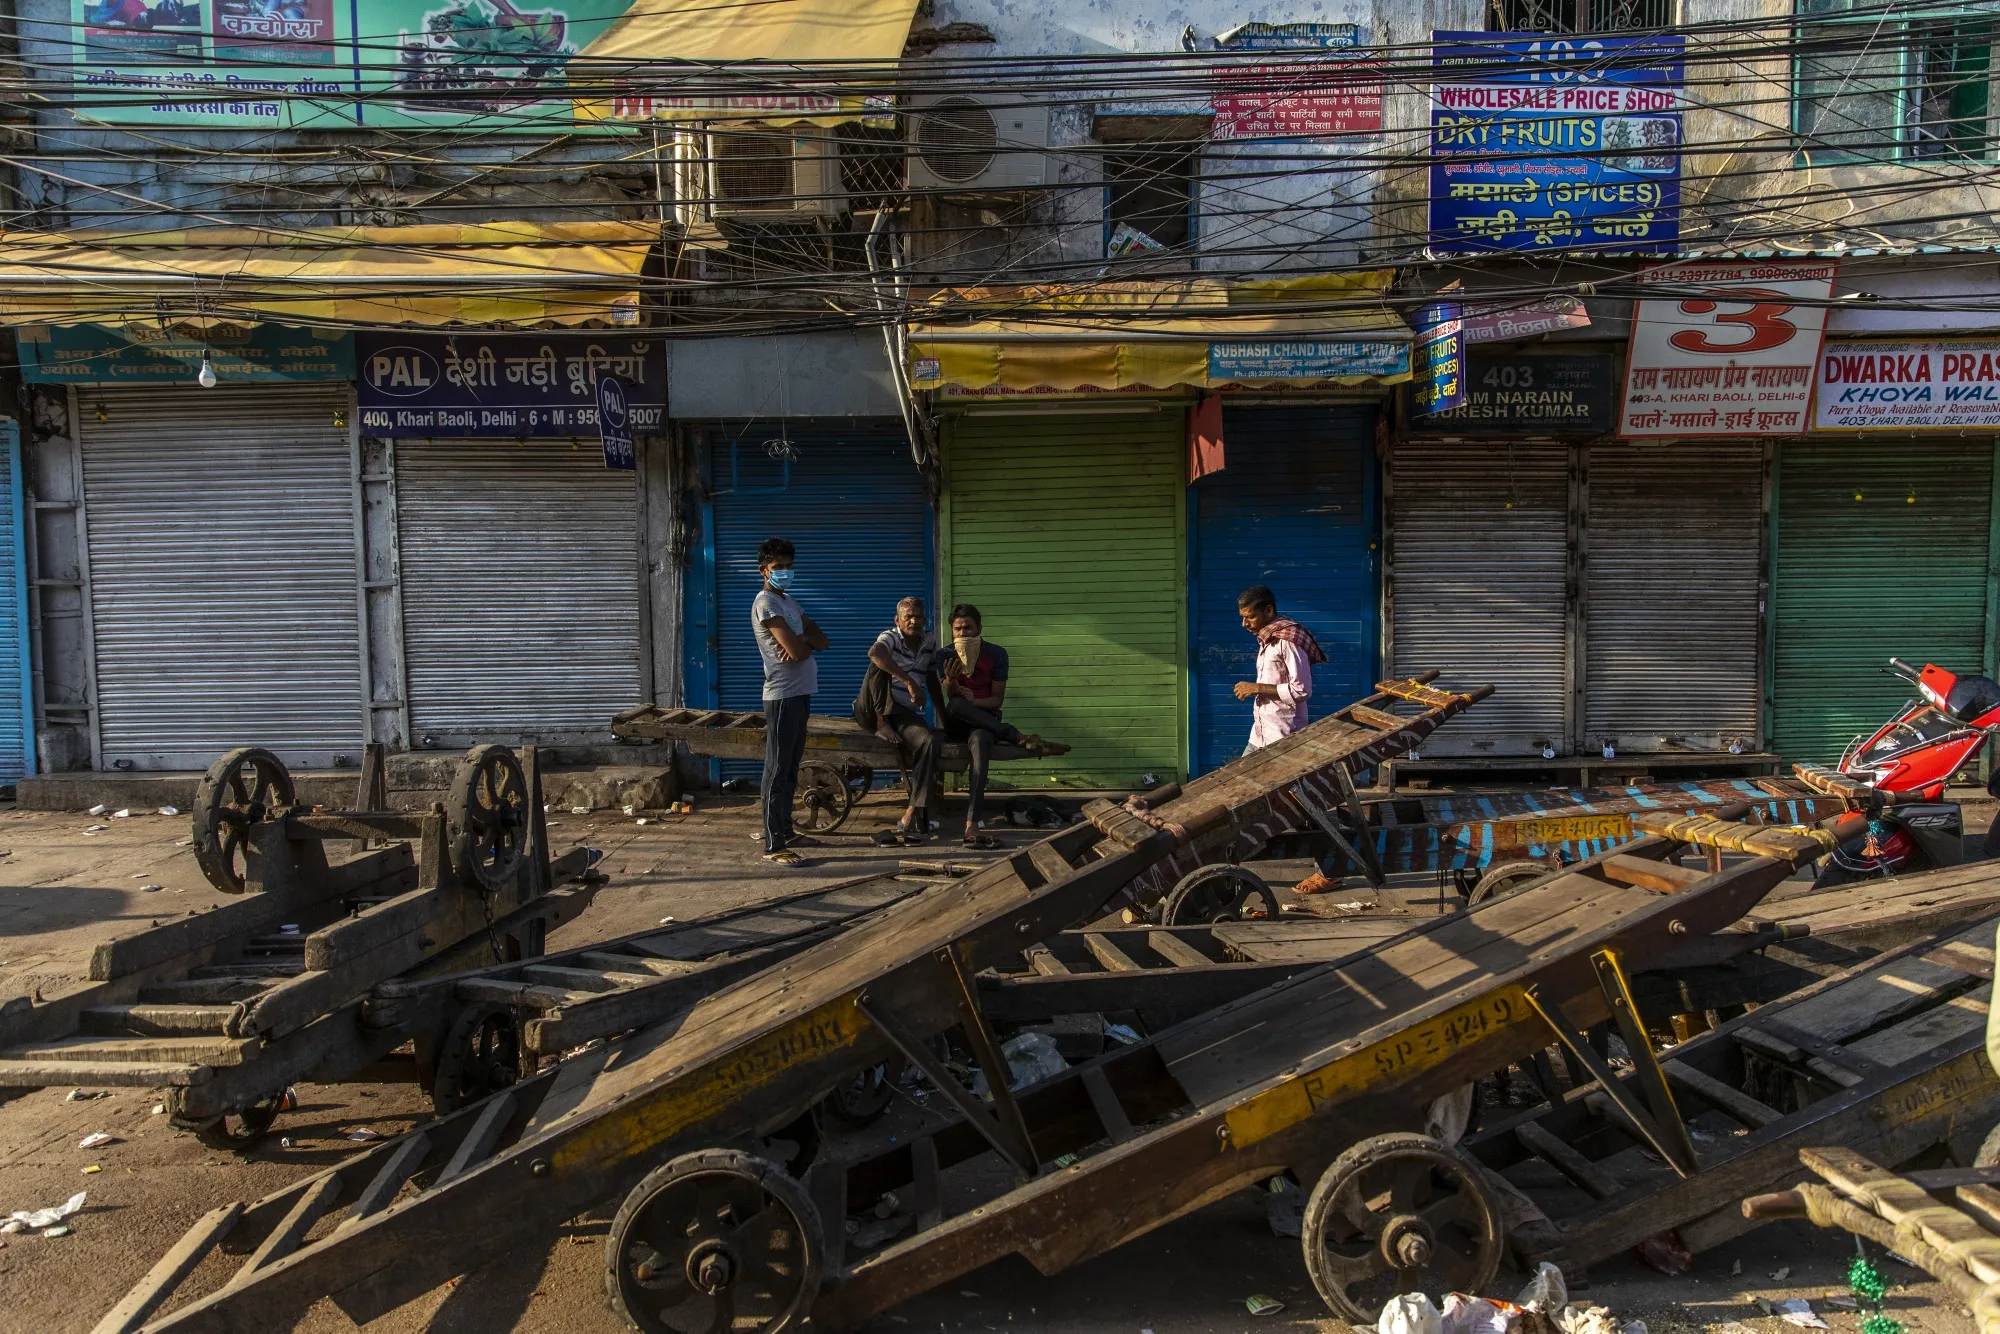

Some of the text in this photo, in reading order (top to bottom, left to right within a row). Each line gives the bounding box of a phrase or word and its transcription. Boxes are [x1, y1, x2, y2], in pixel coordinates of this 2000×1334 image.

[1277, 24, 1313, 37] NIKHIL
[1316, 24, 1355, 37] KUMAR
[1331, 39, 1349, 48] 402
[1302, 98, 1309, 106] व
[1312, 97, 1337, 106] मसाले
[1341, 96, 1350, 105] के
[1354, 95, 1380, 105] विक्रेता
[1439, 87, 1676, 110] WHOLESALE PRICE SHOP
[1321, 110, 1332, 119] का
[1336, 108, 1354, 118] सभी
[1357, 110, 1381, 118] समान
[1211, 121, 1236, 139] 402
[1246, 121, 1270, 131] उचित
[1274, 120, 1286, 130] रेट
[1290, 121, 1301, 130] पर
[1305, 119, 1331, 130] मिलता
[1438, 117, 1597, 147] DRY FRUITS
[1450, 178, 1541, 203] मसाले
[1547, 182, 1662, 207] (SPICES)
[1455, 210, 1518, 242] जड़ी
[1427, 306, 1441, 322] 403
[1667, 287, 1797, 355] 3
[1463, 326, 1494, 340] मान
[1497, 319, 1552, 337] मिलता
[1214, 344, 1270, 358] SUBHASH
[1274, 343, 1314, 356] CHAND
[1318, 342, 1358, 356] NIKHIL
[1414, 348, 1428, 367] DRY
[1430, 337, 1458, 361] FRUITS
[373, 356, 430, 386] PAL
[445, 346, 498, 386] देशी
[504, 345, 558, 392] जड़ी
[1433, 358, 1459, 379] (SPICES)
[1482, 365, 1535, 389] 403
[1632, 359, 1812, 390] राम नारायण प्रेम नारायण
[1825, 353, 2000, 384] DWARKA PRA
[603, 389, 624, 415] PAL
[1463, 390, 1574, 405] AM NARAIN
[1670, 391, 1710, 402] KHARI
[1713, 391, 1754, 402] BAOLI,
[1758, 391, 1806, 402] DELHI-6
[1839, 386, 1932, 403] KHOYA
[1514, 404, 1590, 418] KUMAR
[1827, 404, 1853, 415] Pure
[1856, 404, 1886, 416] Khoya
[1890, 402, 1932, 414] Available
[1934, 404, 1946, 413] at
[363, 410, 564, 430] 400, Khari Baoli, Delhi 6 M
